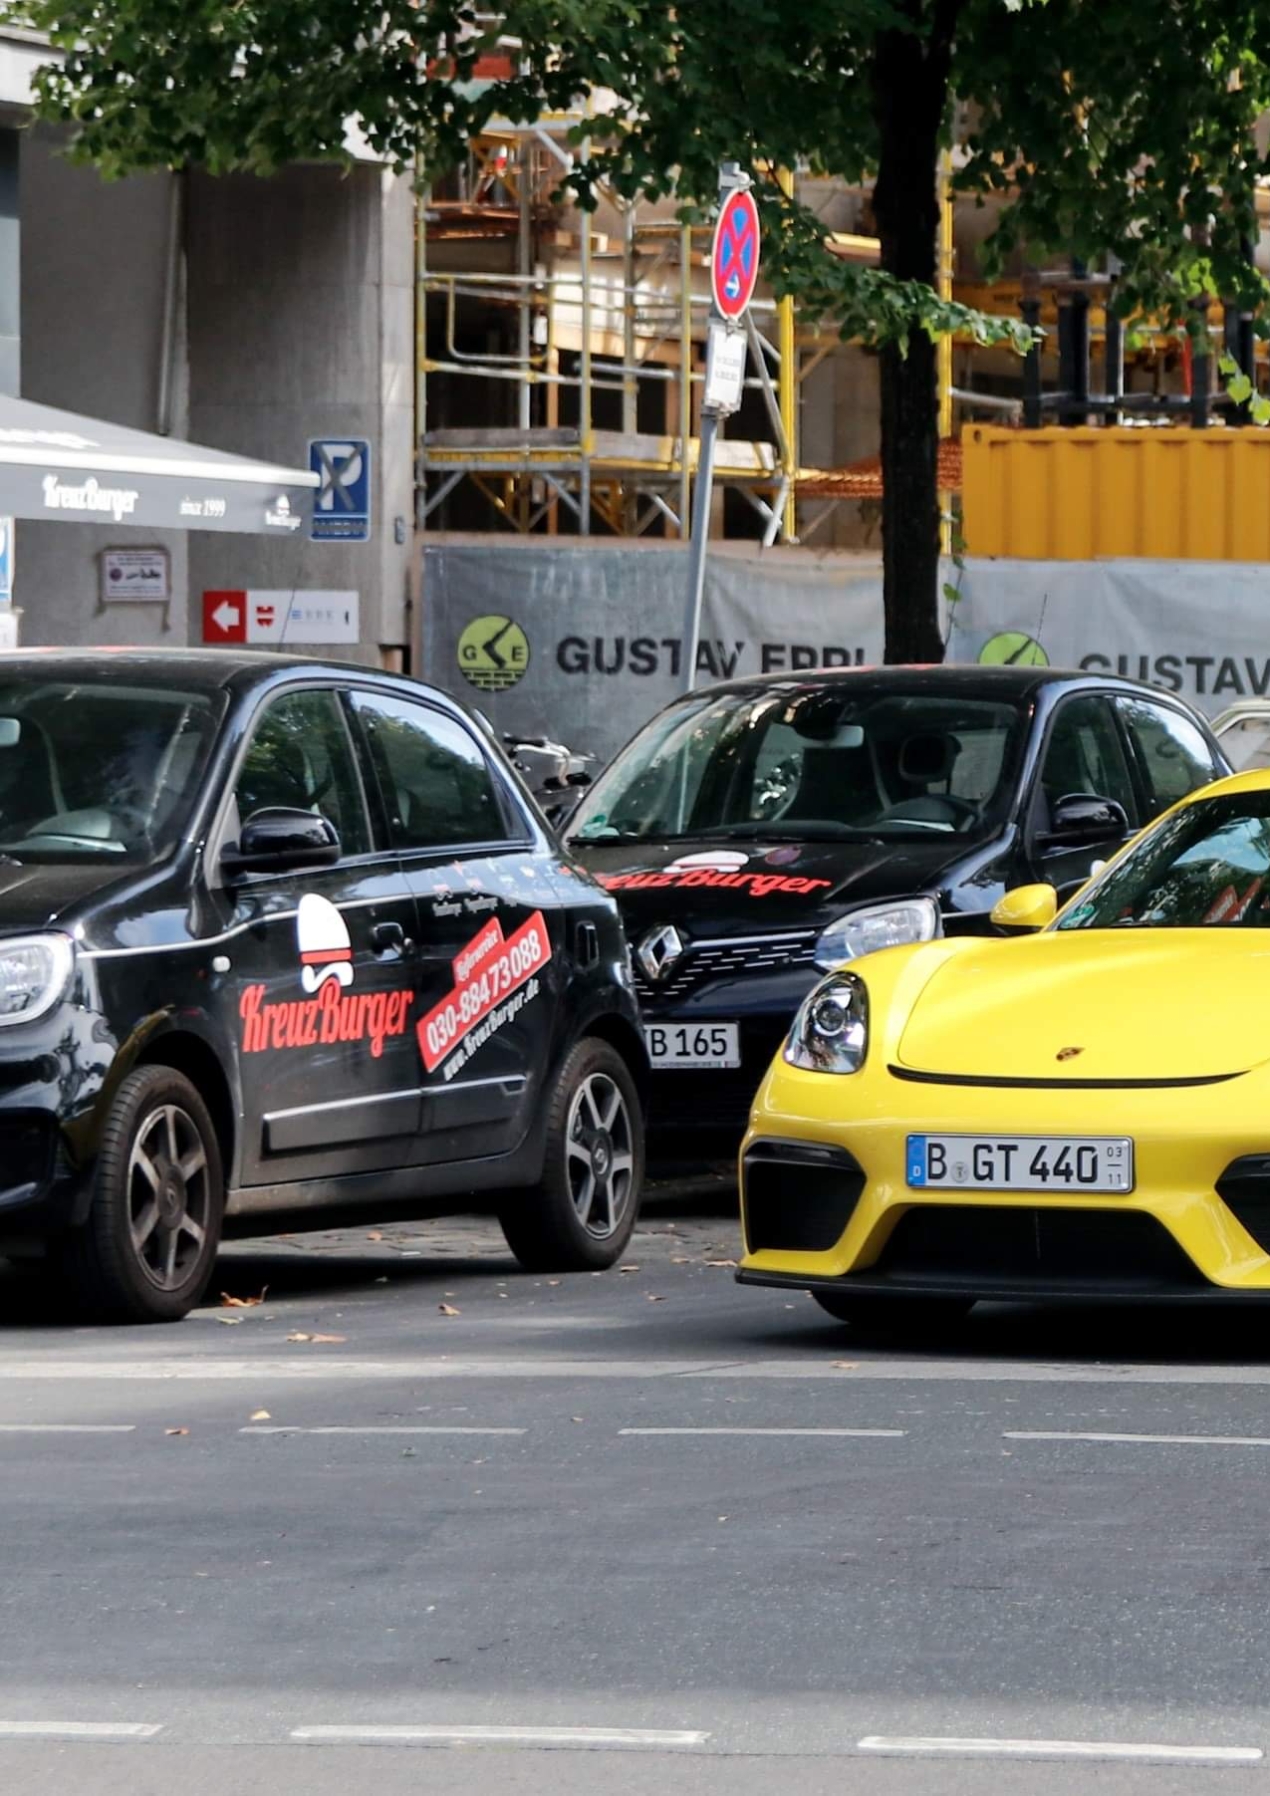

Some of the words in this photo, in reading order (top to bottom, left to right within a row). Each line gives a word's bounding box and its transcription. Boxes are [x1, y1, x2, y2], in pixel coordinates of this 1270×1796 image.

[42, 473, 139, 522] KreuzBurger
[462, 644, 478, 661] G
[511, 645, 525, 662] E
[556, 636, 746, 679] GUSTAV
[239, 976, 414, 1059] KreuzBurger
[675, 1028, 727, 1057] 165
[927, 1142, 948, 1180] B
[973, 1143, 1019, 1182] GT
[1029, 1144, 1098, 1183] 440
[1106, 1146, 1123, 1158] 03
[1107, 1173, 1123, 1185] 11
